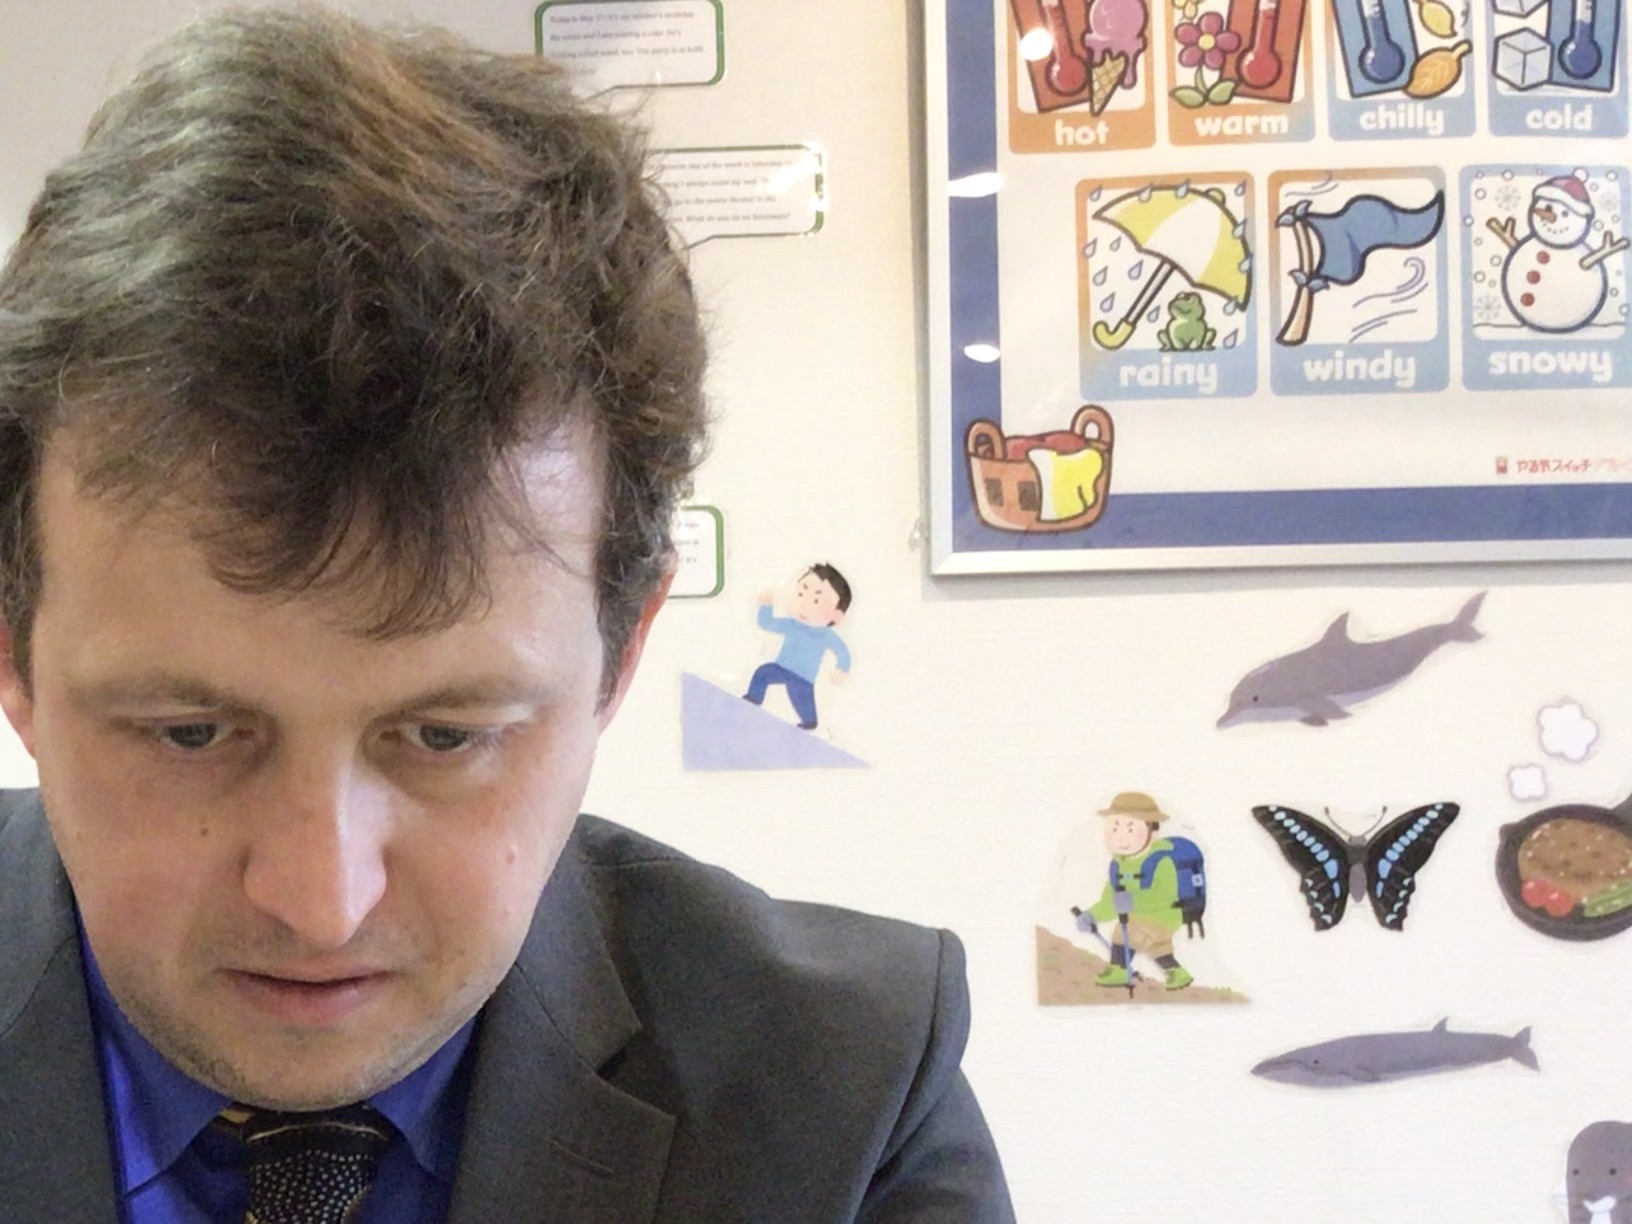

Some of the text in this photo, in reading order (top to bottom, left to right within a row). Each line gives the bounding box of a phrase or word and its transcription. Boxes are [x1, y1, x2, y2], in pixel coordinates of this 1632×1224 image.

[1055, 119, 1109, 146] hot
[1194, 114, 1289, 136] warm
[1359, 103, 1444, 135] chilly
[1525, 103, 1594, 130] cold
[1119, 355, 1218, 393] rainy
[1304, 349, 1416, 387] windy
[1489, 345, 1612, 381] snowy
